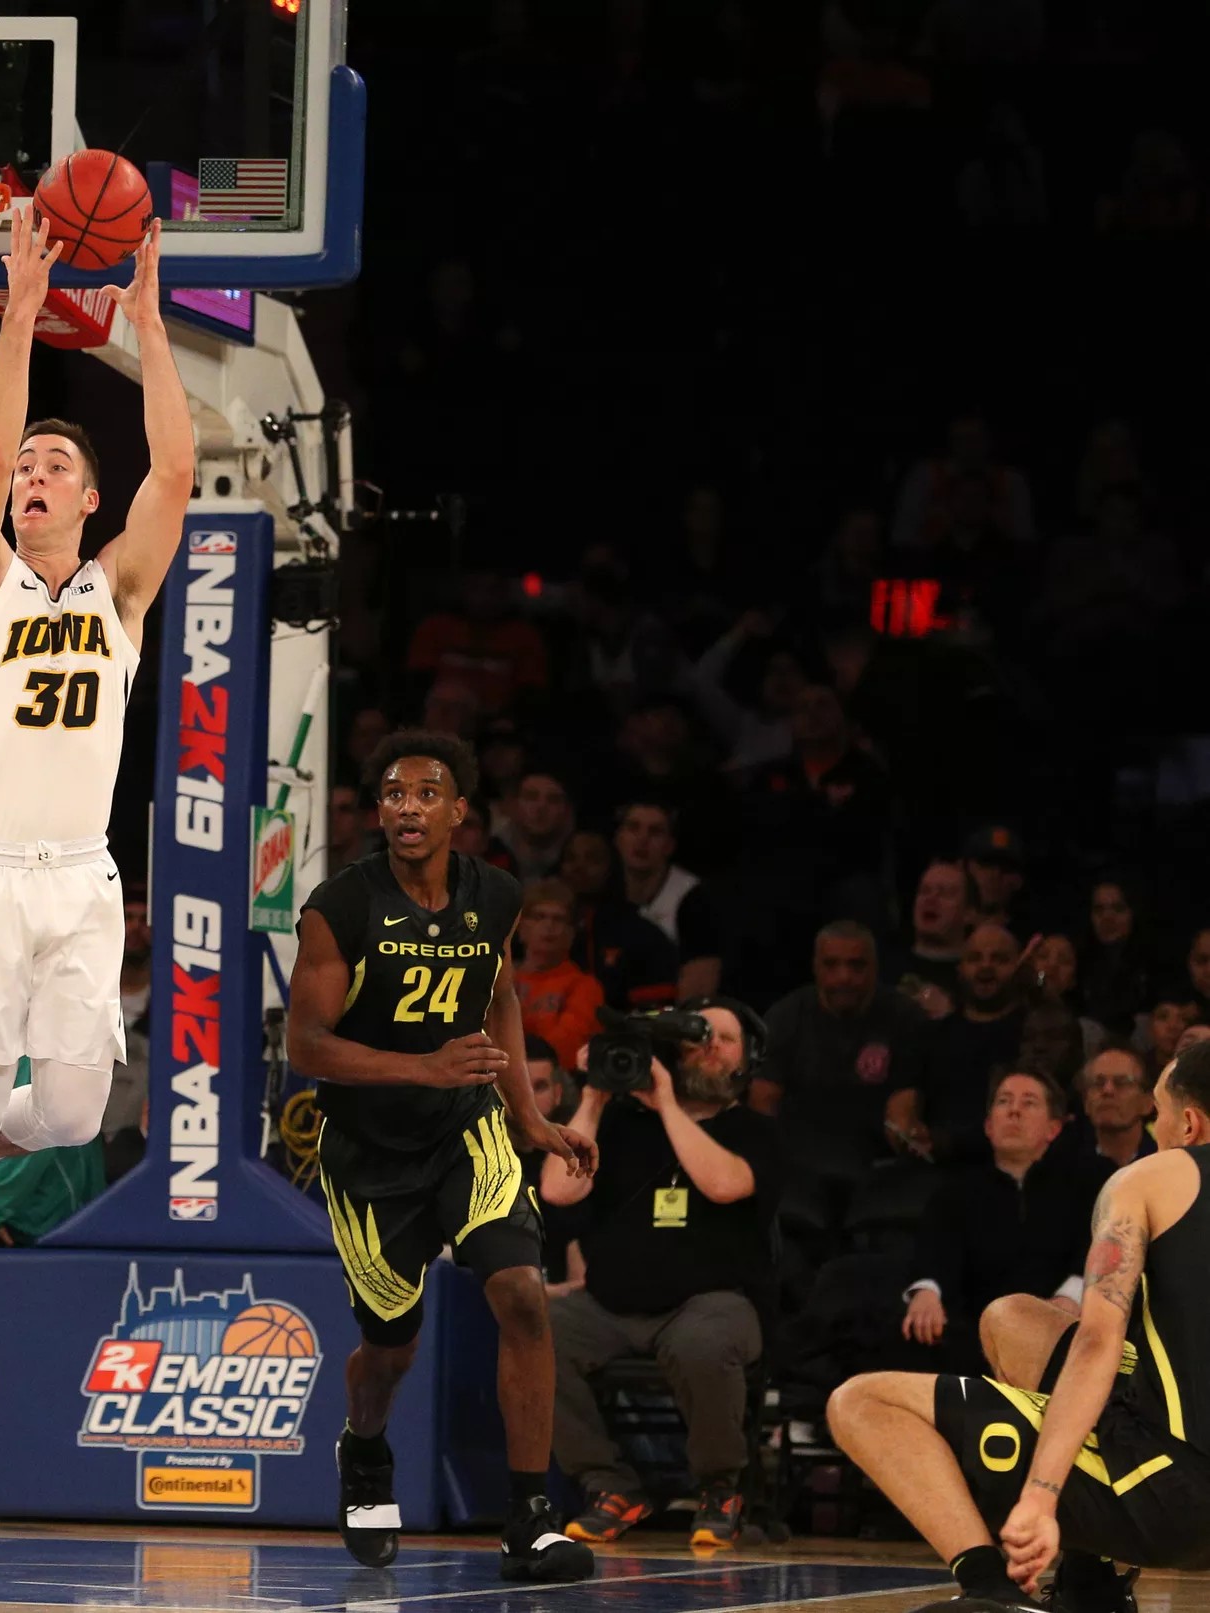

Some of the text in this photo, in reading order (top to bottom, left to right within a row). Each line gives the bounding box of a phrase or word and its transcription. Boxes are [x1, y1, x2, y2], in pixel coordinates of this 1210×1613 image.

[0, 610, 113, 668] IOWA
[13, 669, 101, 731] 30
[378, 941, 490, 958] OREGON
[393, 965, 467, 1023] 24
[97, 1344, 317, 1396] 2K EMPIRE
[87, 1394, 302, 1437] CLASSIC
[165, 1455, 234, 1469] Presented By
[247, 1438, 300, 1451] PROJECT
[979, 1422, 1021, 1472] O
[148, 1476, 234, 1495] Continental
